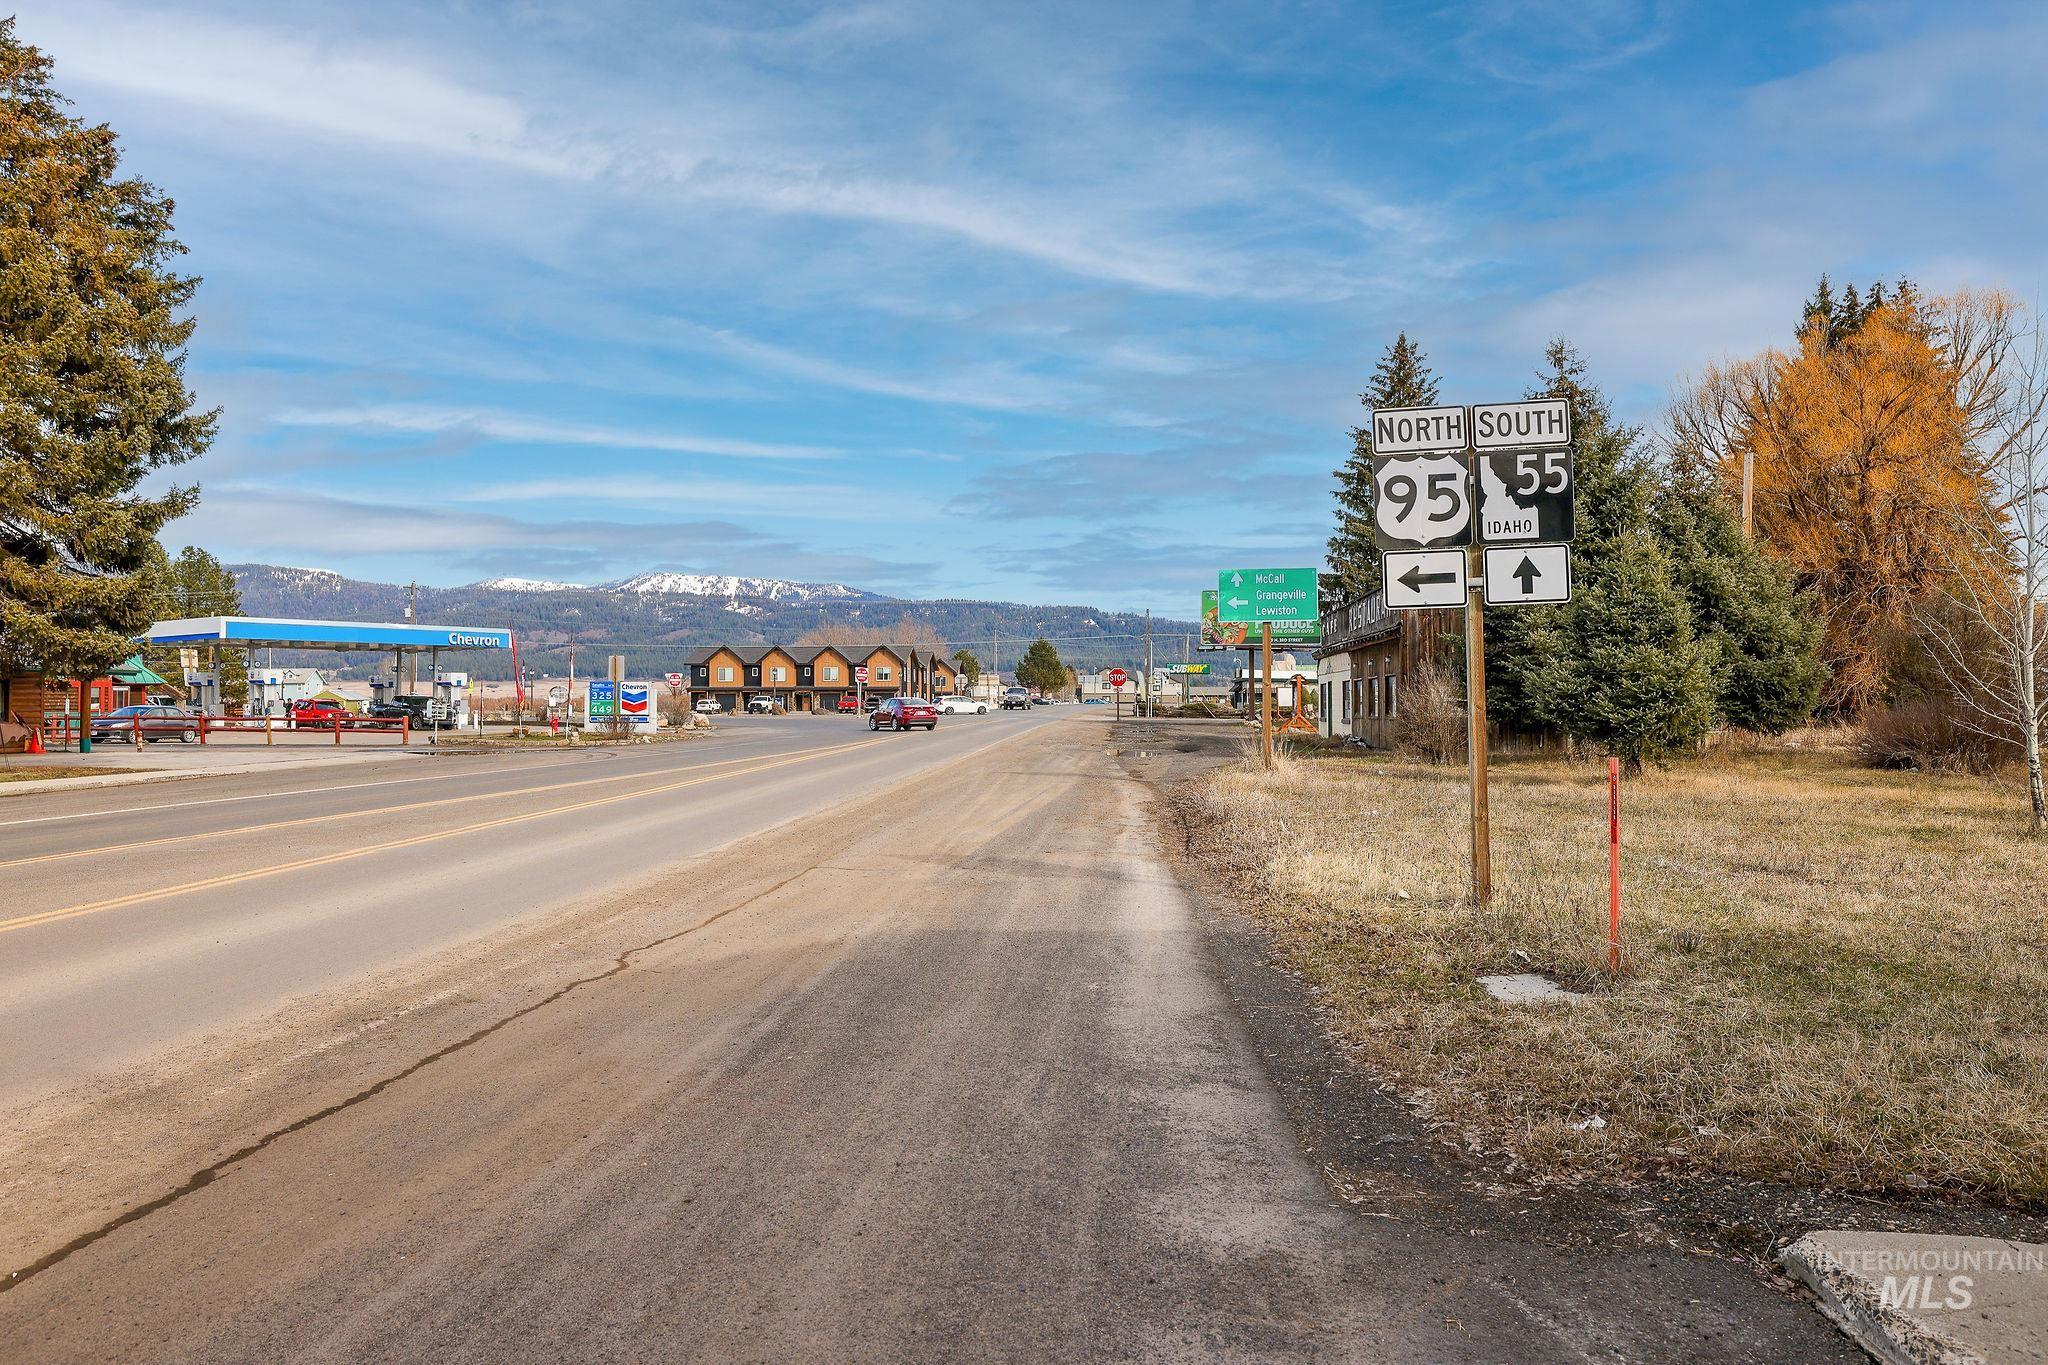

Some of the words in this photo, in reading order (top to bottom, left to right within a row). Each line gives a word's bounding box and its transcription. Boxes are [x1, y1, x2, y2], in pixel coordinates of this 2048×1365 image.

[1377, 415, 1462, 444] NORTH
[1478, 409, 1564, 438] SOUTH
[1516, 452, 1569, 496] 55
[1383, 472, 1461, 524] 95
[1487, 519, 1532, 535] IDAHO
[1255, 573, 1285, 584] McCall
[1256, 589, 1307, 603] Grangeville
[1255, 605, 1297, 616] Lewiston
[1254, 620, 1314, 629] PODUCE
[448, 632, 500, 646] Chevron
[1170, 664, 1207, 673] SUBWAY
